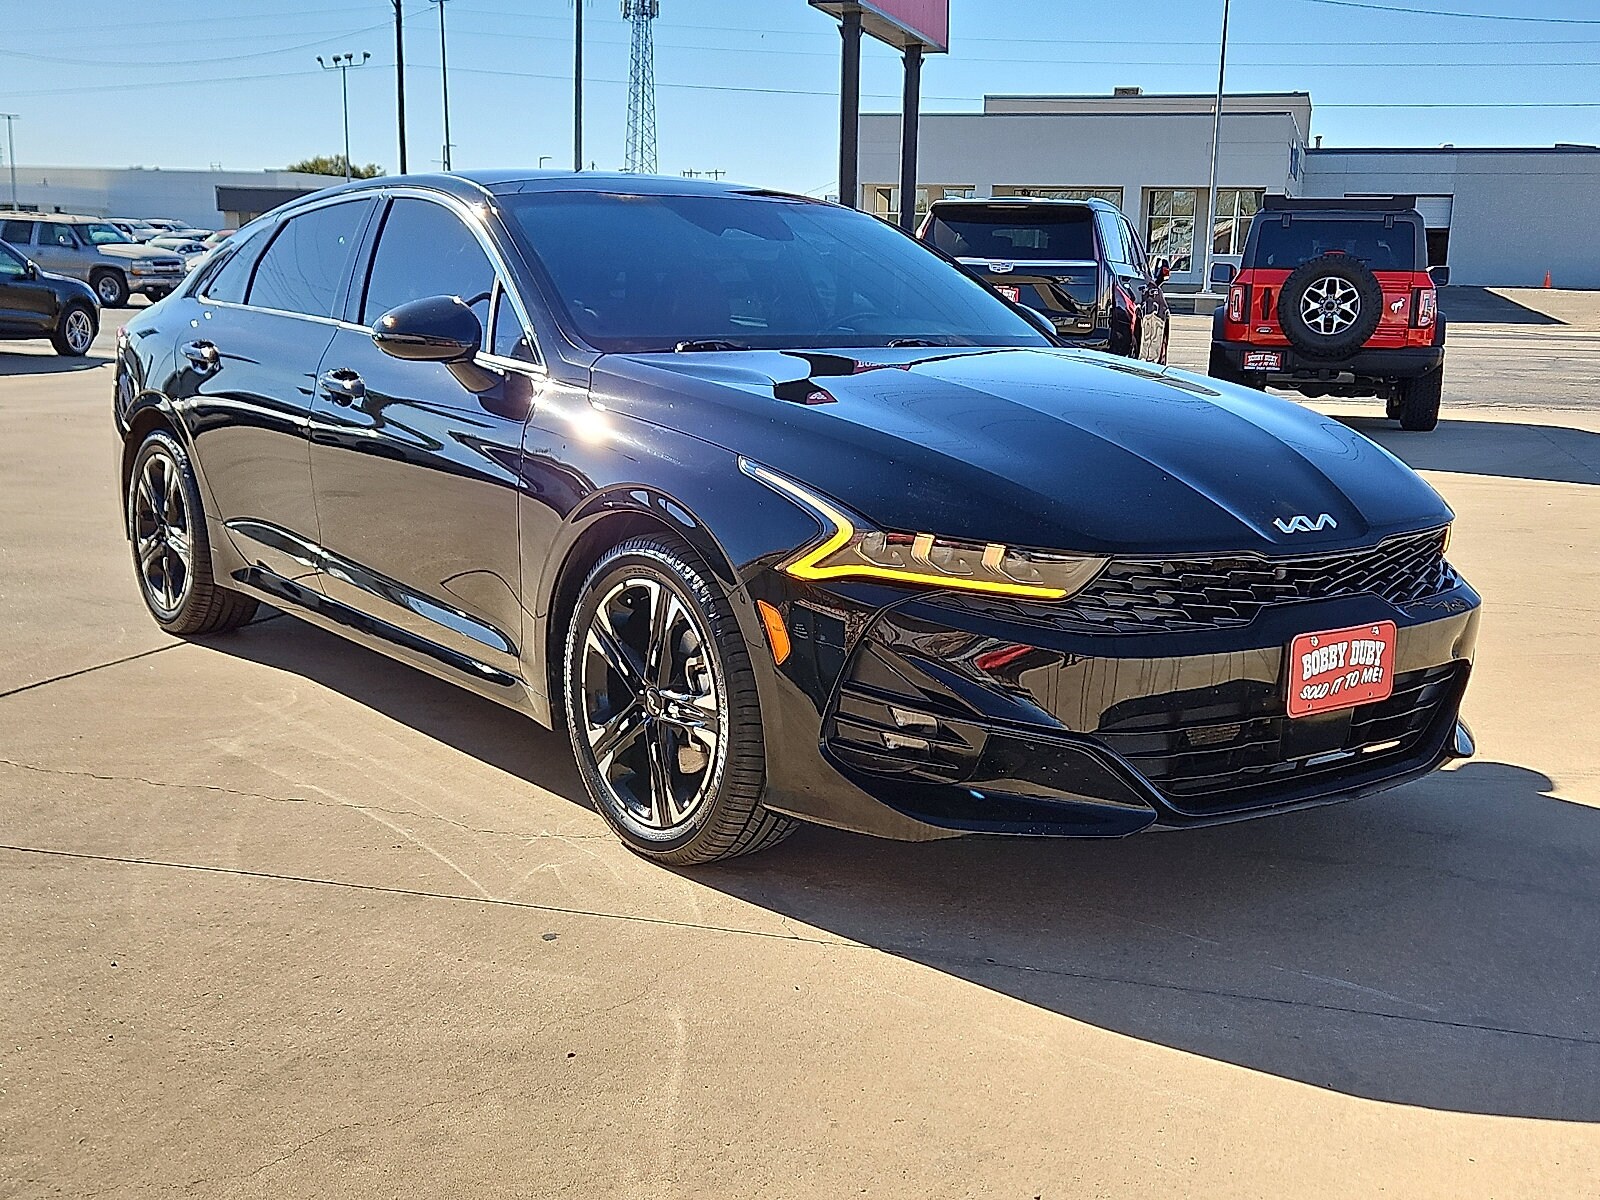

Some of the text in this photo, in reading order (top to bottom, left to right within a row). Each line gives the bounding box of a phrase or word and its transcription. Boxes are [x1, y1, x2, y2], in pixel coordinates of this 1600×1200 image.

[1301, 640, 1386, 681] BOBBY DUBY
[1300, 667, 1384, 700] SOLD IT TO ME!
